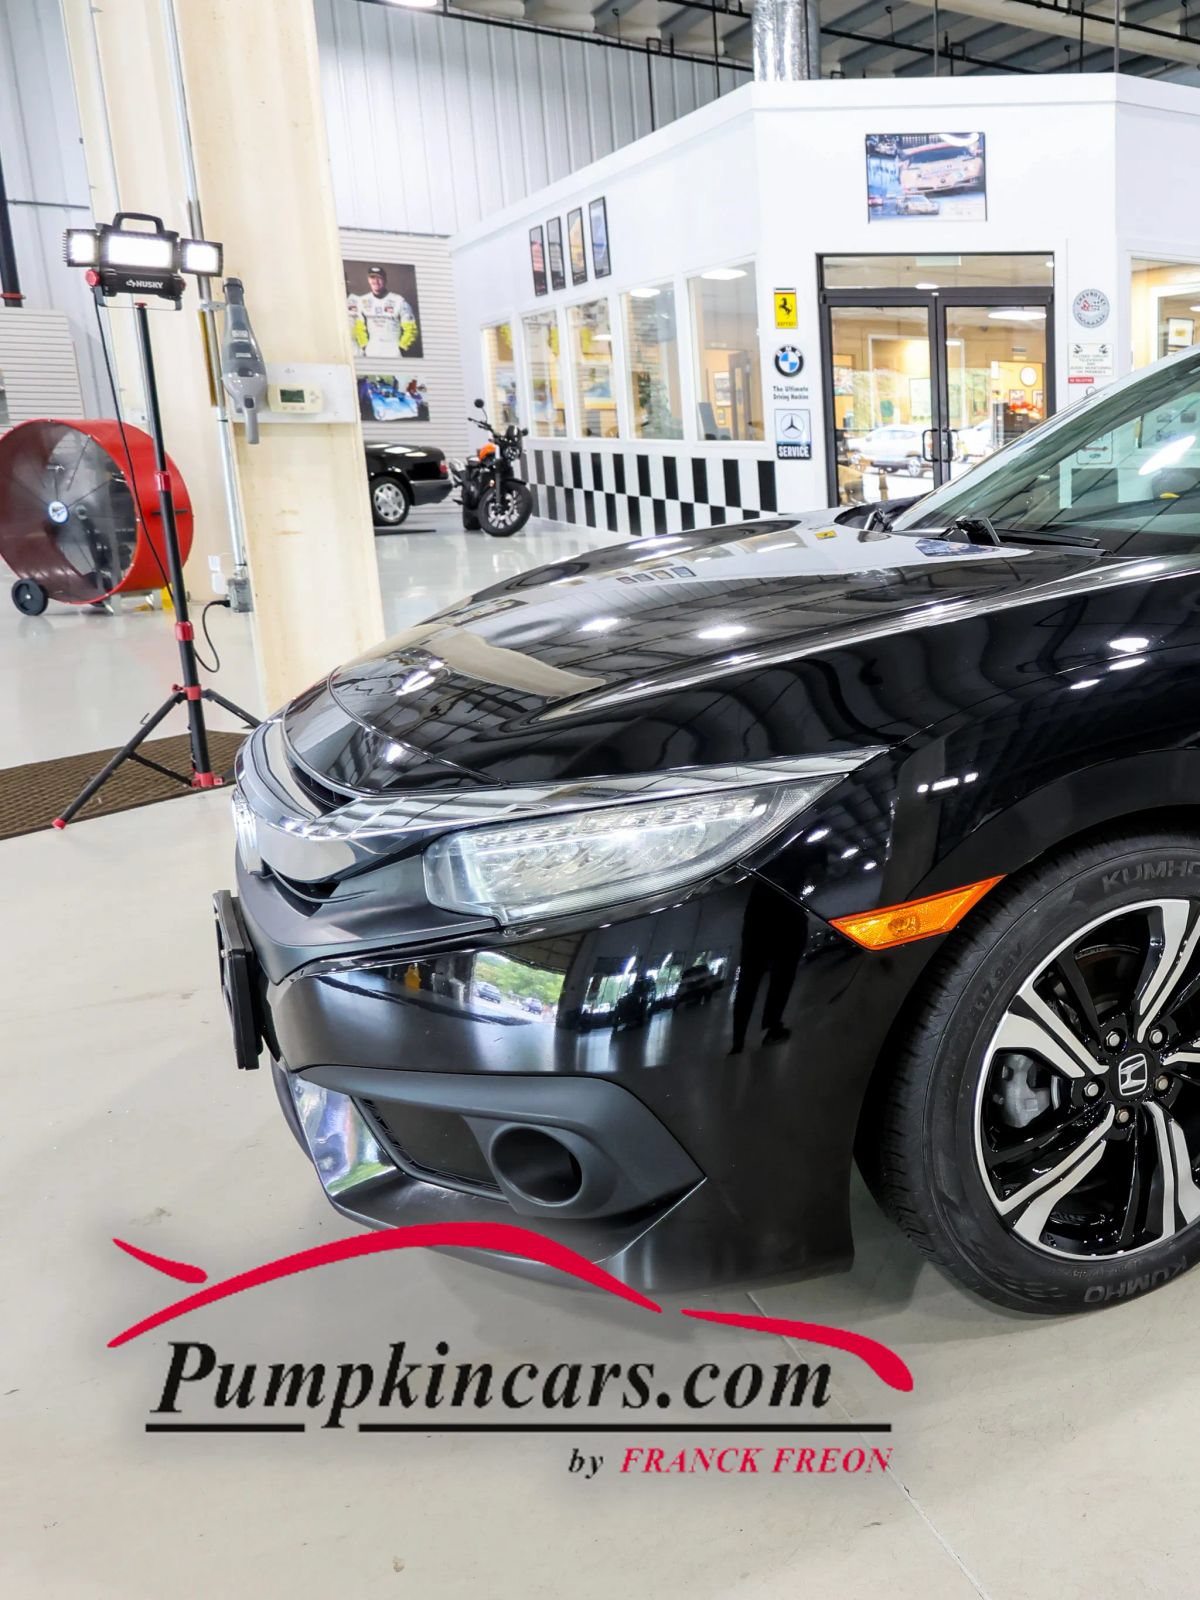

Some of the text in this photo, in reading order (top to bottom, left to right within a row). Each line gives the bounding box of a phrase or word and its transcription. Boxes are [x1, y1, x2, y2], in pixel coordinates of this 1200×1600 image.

[136, 280, 163, 289] HUSKY
[773, 393, 790, 401] Driving
[779, 446, 809, 457] SERVICE
[1084, 1255, 1187, 1302] KUMHO
